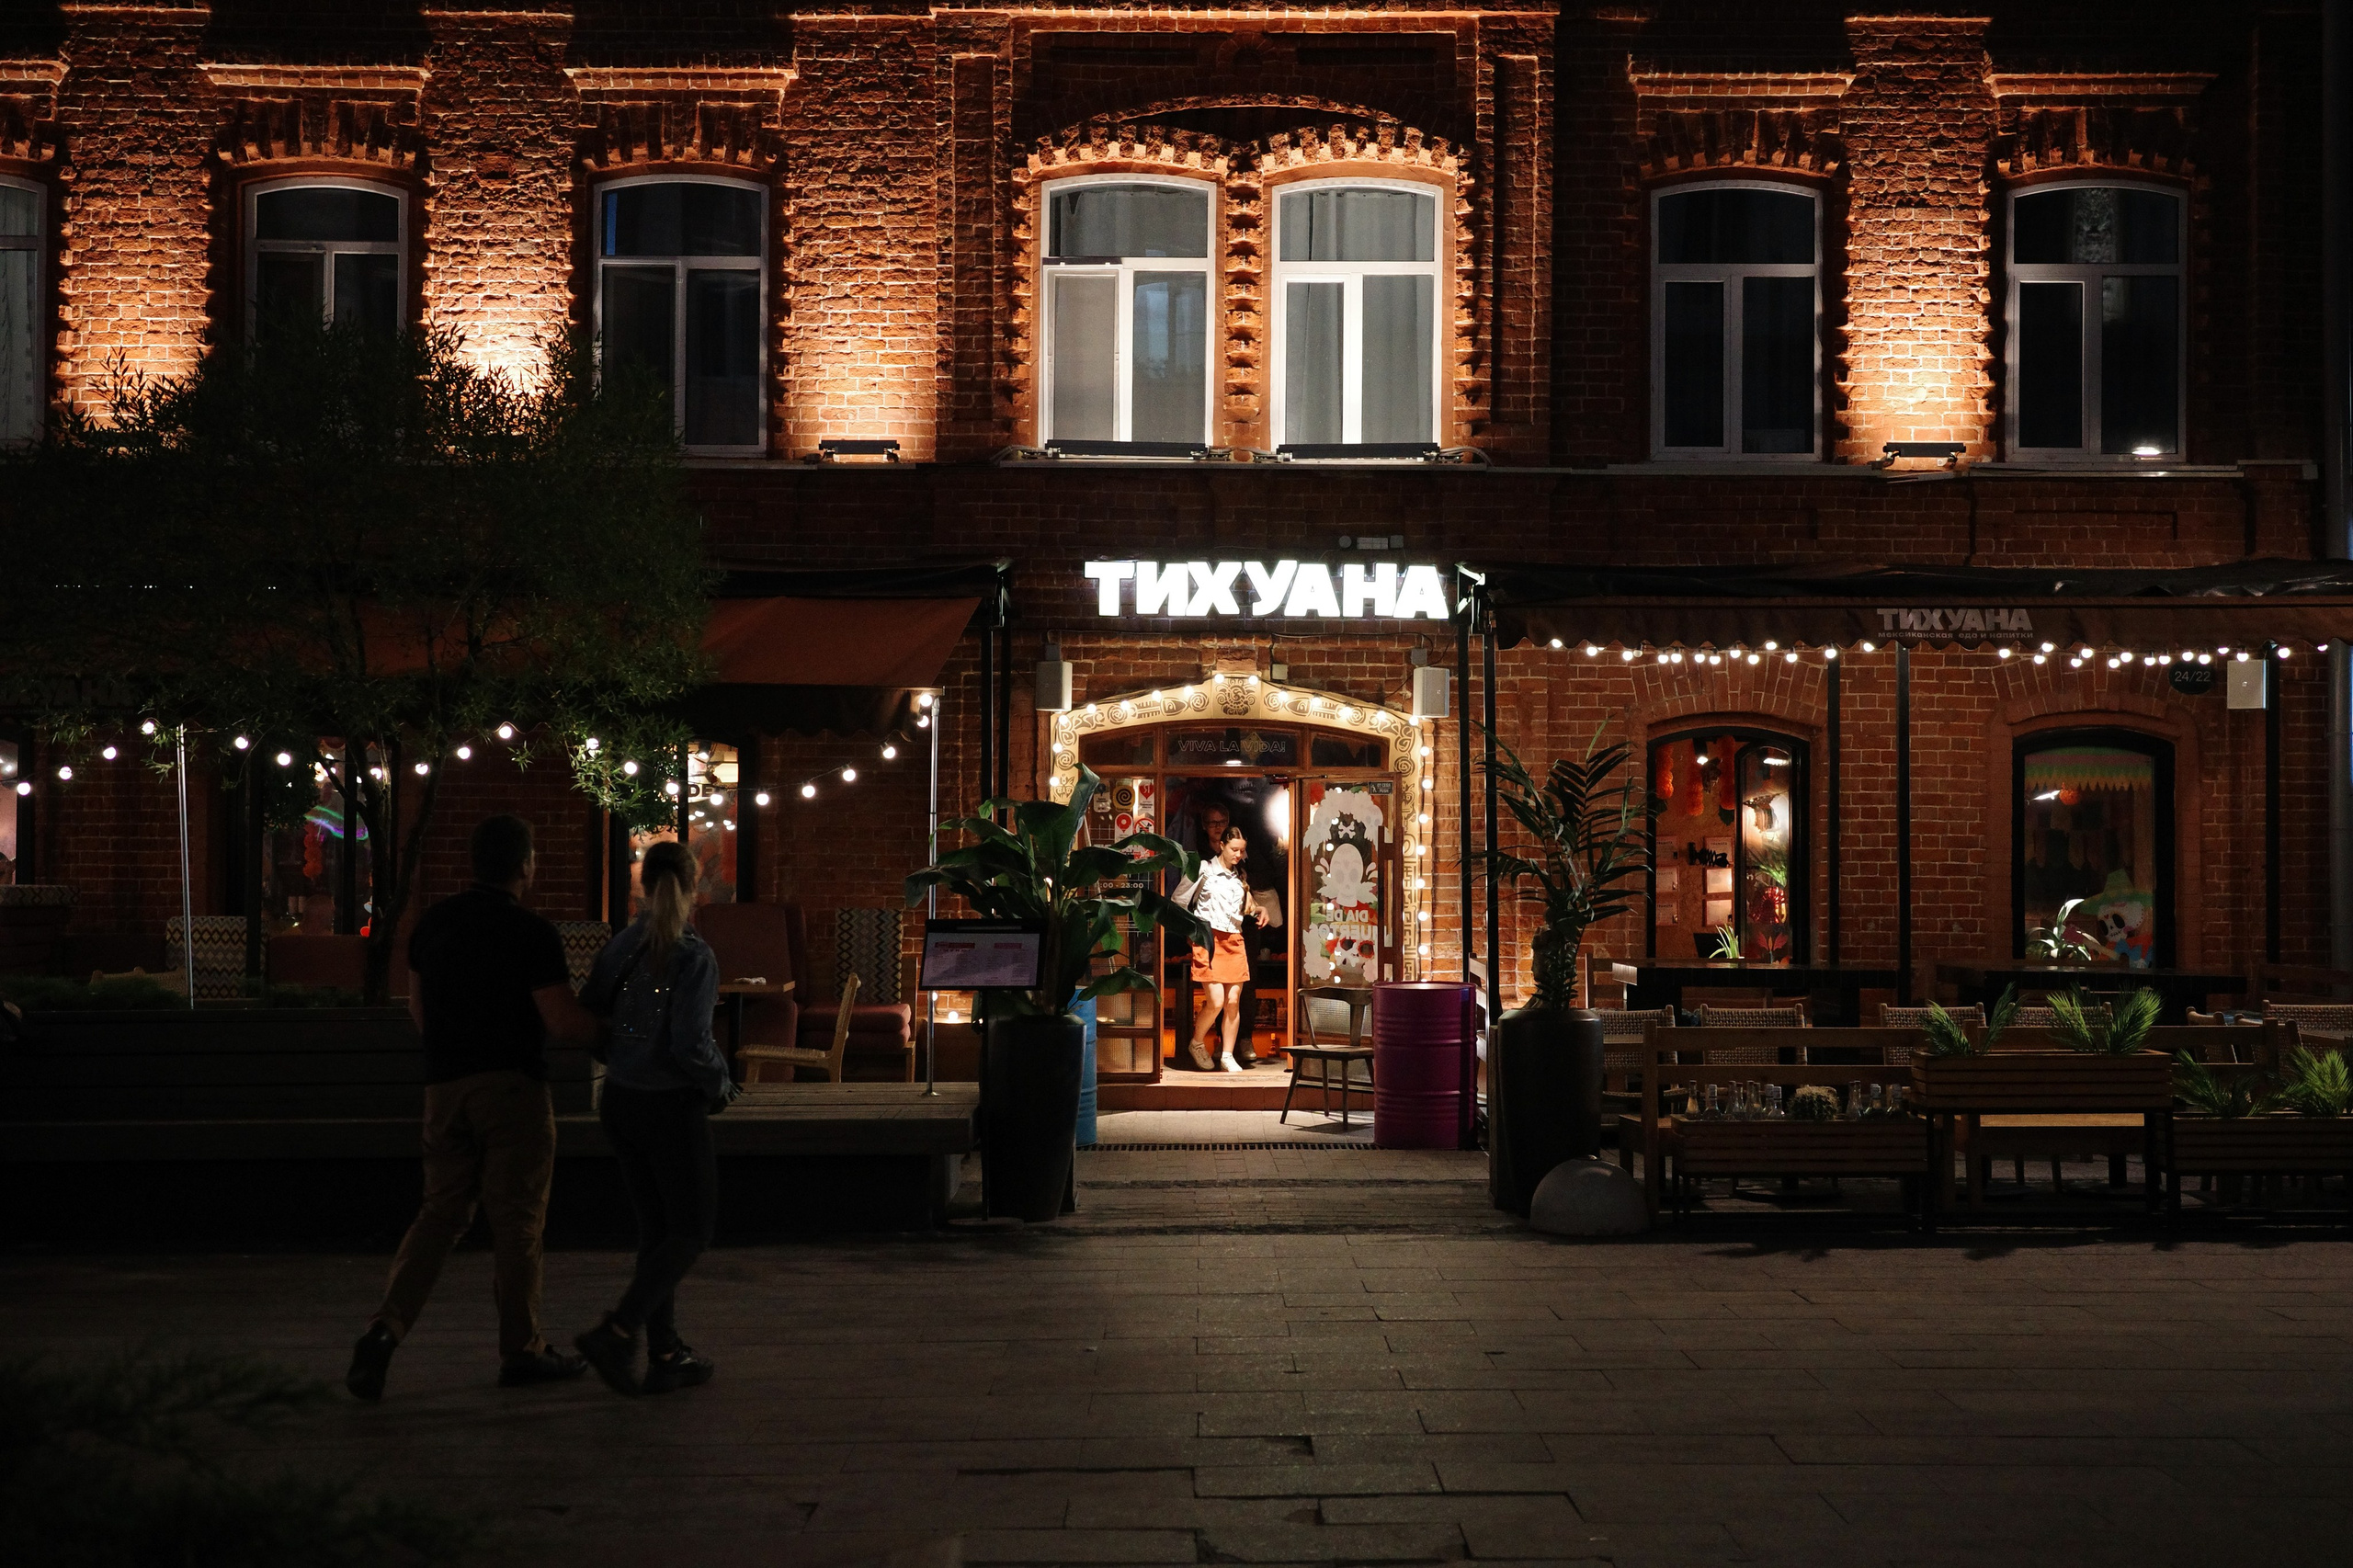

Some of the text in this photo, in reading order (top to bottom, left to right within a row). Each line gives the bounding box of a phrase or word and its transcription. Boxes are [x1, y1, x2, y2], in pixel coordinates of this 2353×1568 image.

[1085, 560, 1449, 619] ТИХУАНА
[1877, 608, 2033, 631] ТИХУАНА
[2175, 671, 2211, 682] 24/22
[1178, 740, 1286, 753] VIVA LA VIDA!
